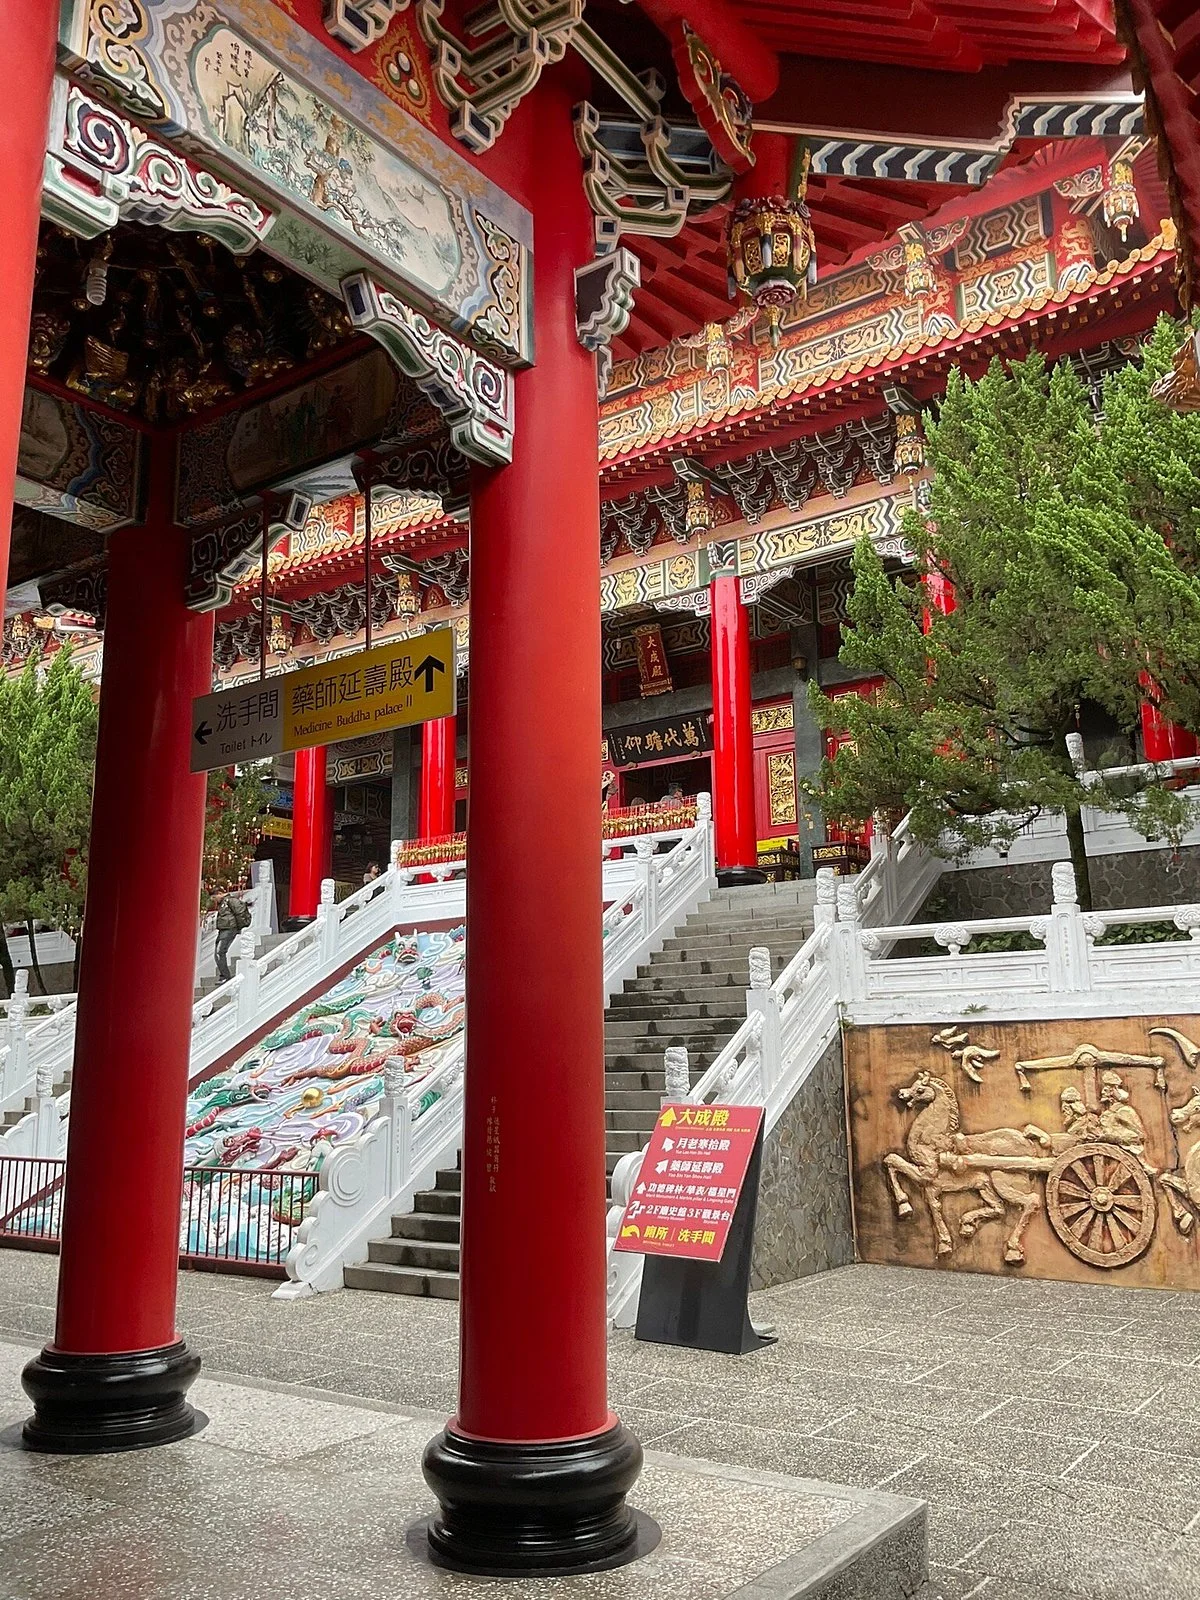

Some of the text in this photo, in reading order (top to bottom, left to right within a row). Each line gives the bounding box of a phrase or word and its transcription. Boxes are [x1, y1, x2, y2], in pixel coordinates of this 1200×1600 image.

[646, 635, 664, 678] 大成殿
[291, 656, 414, 716] 藥師延壽殿
[216, 689, 279, 732] 洗手間
[293, 719, 333, 737] Medicine
[336, 709, 371, 726] Buddha
[374, 702, 403, 719] palace
[220, 732, 273, 754] Toilet トイレ
[624, 721, 700, 755] 萬代瞻仰
[676, 1108, 730, 1126] 大成殿
[676, 1137, 731, 1151] 月老寒拾殿
[669, 1160, 725, 1174] 藥師延壽殿
[677, 1228, 716, 1245] 洗手間
